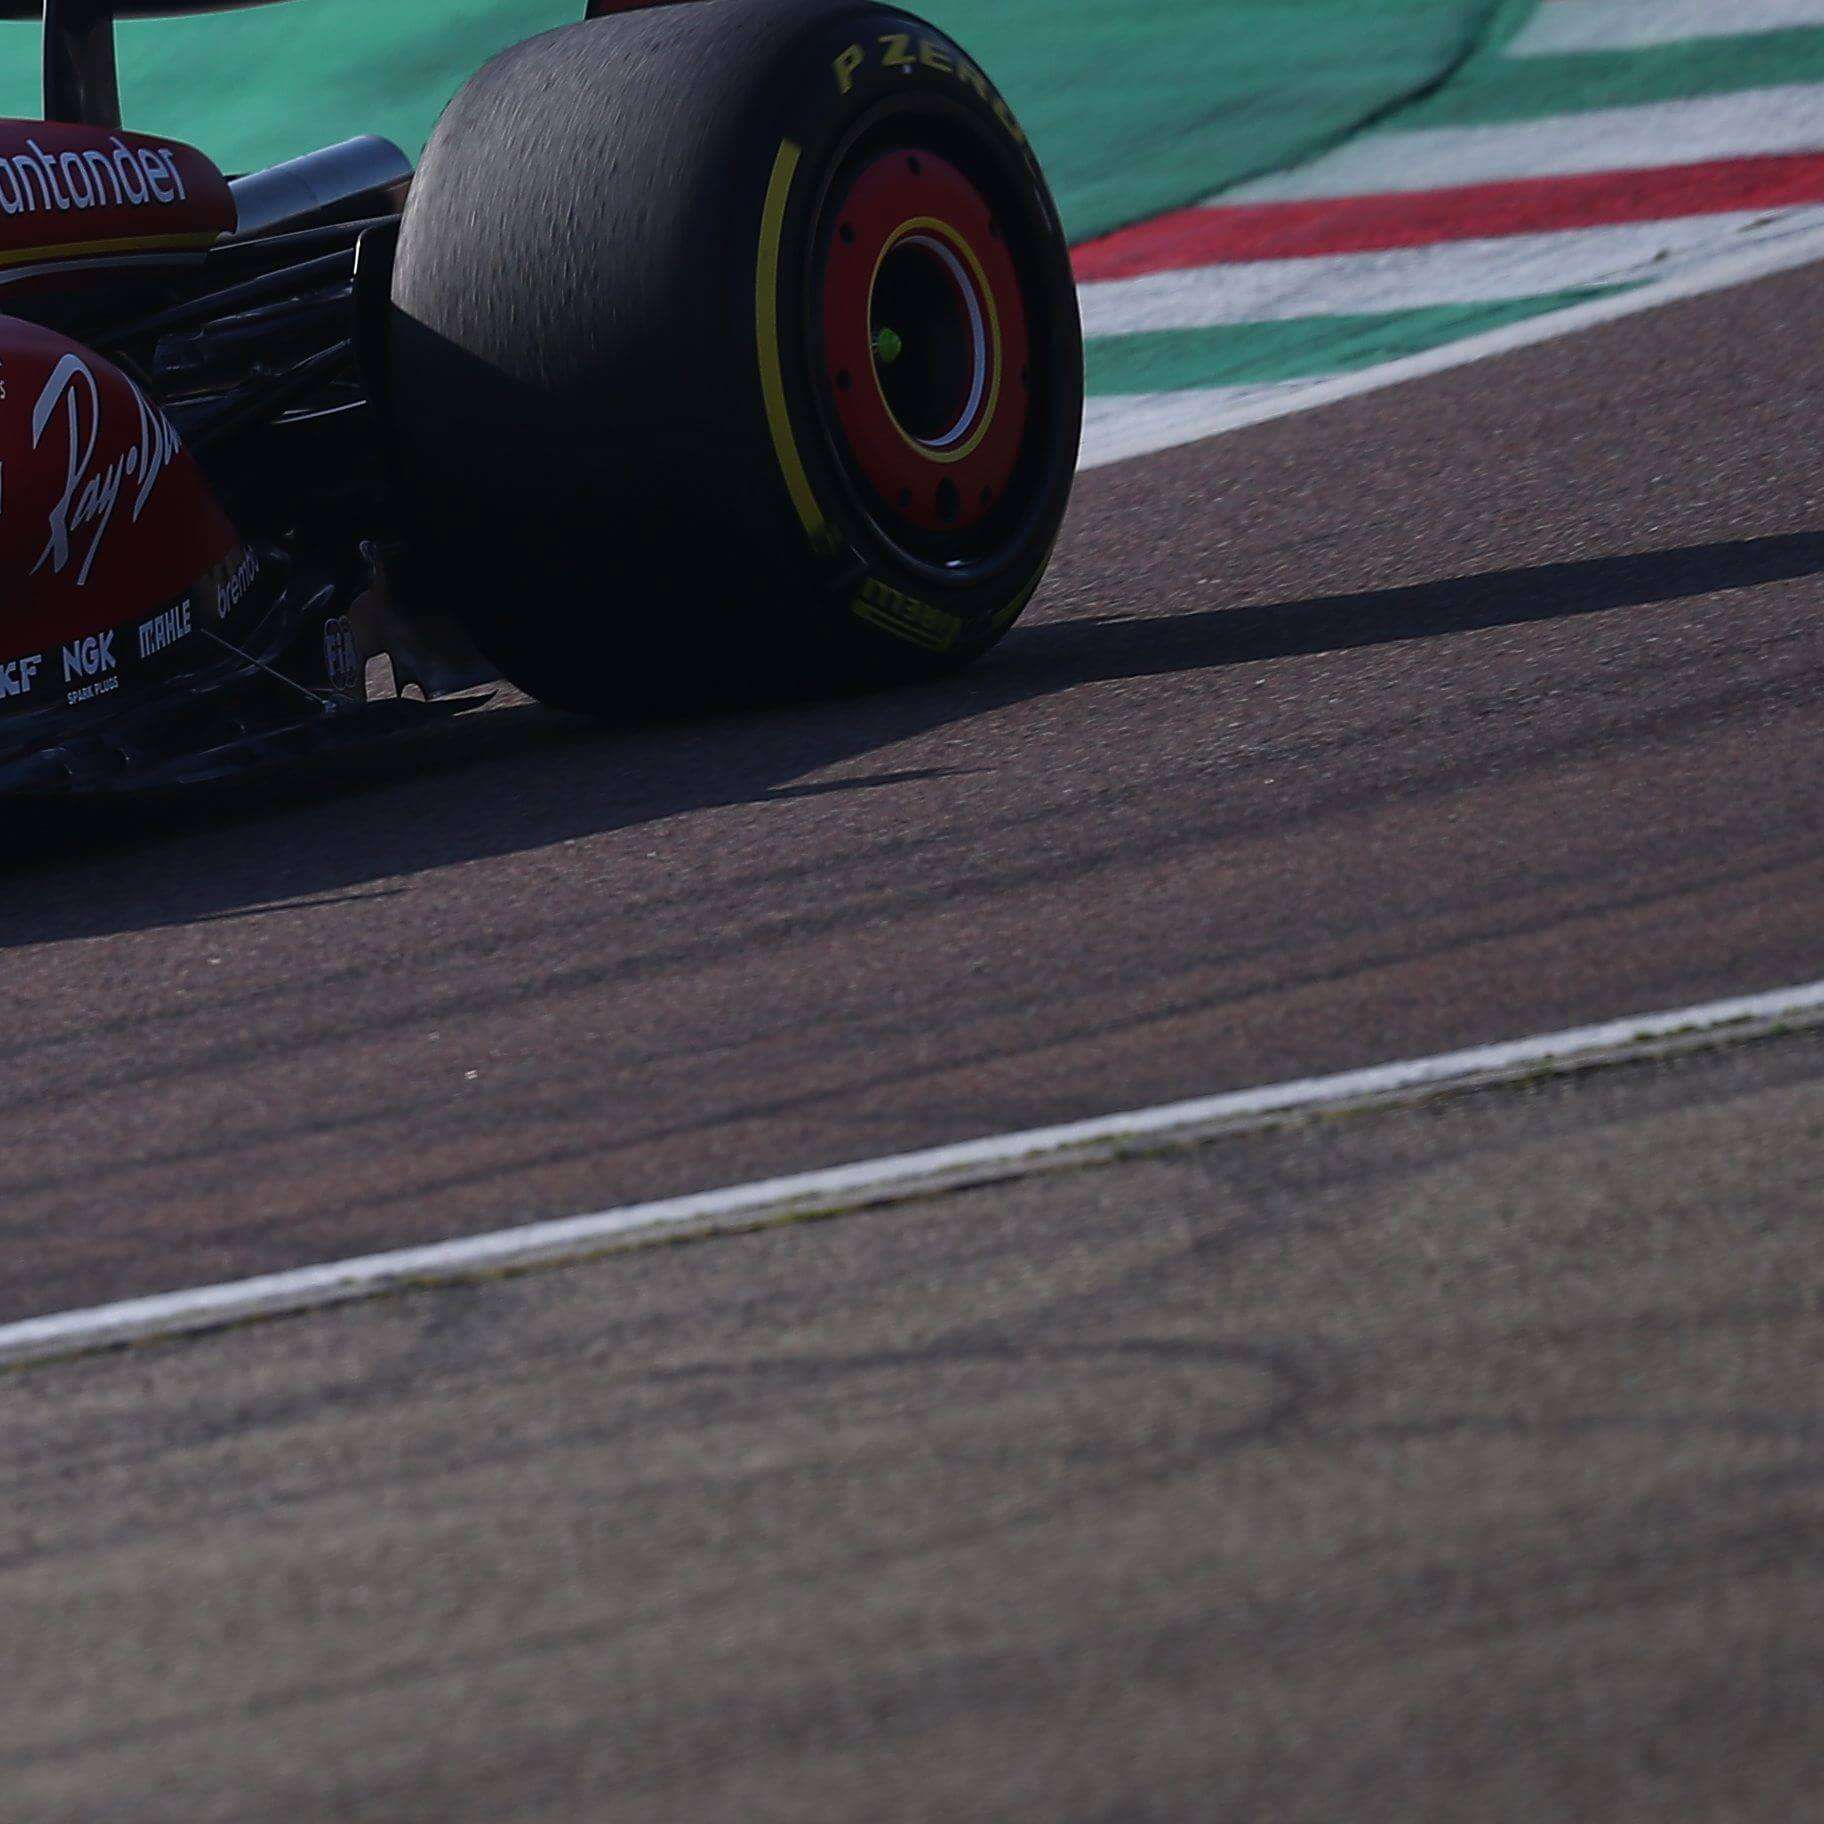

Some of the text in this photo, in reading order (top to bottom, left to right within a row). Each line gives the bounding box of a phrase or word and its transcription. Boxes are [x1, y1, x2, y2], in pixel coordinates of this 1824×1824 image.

[831, 42, 865, 96] P
[61, 629, 117, 683] NGK
[138, 598, 192, 659] MAHLE
